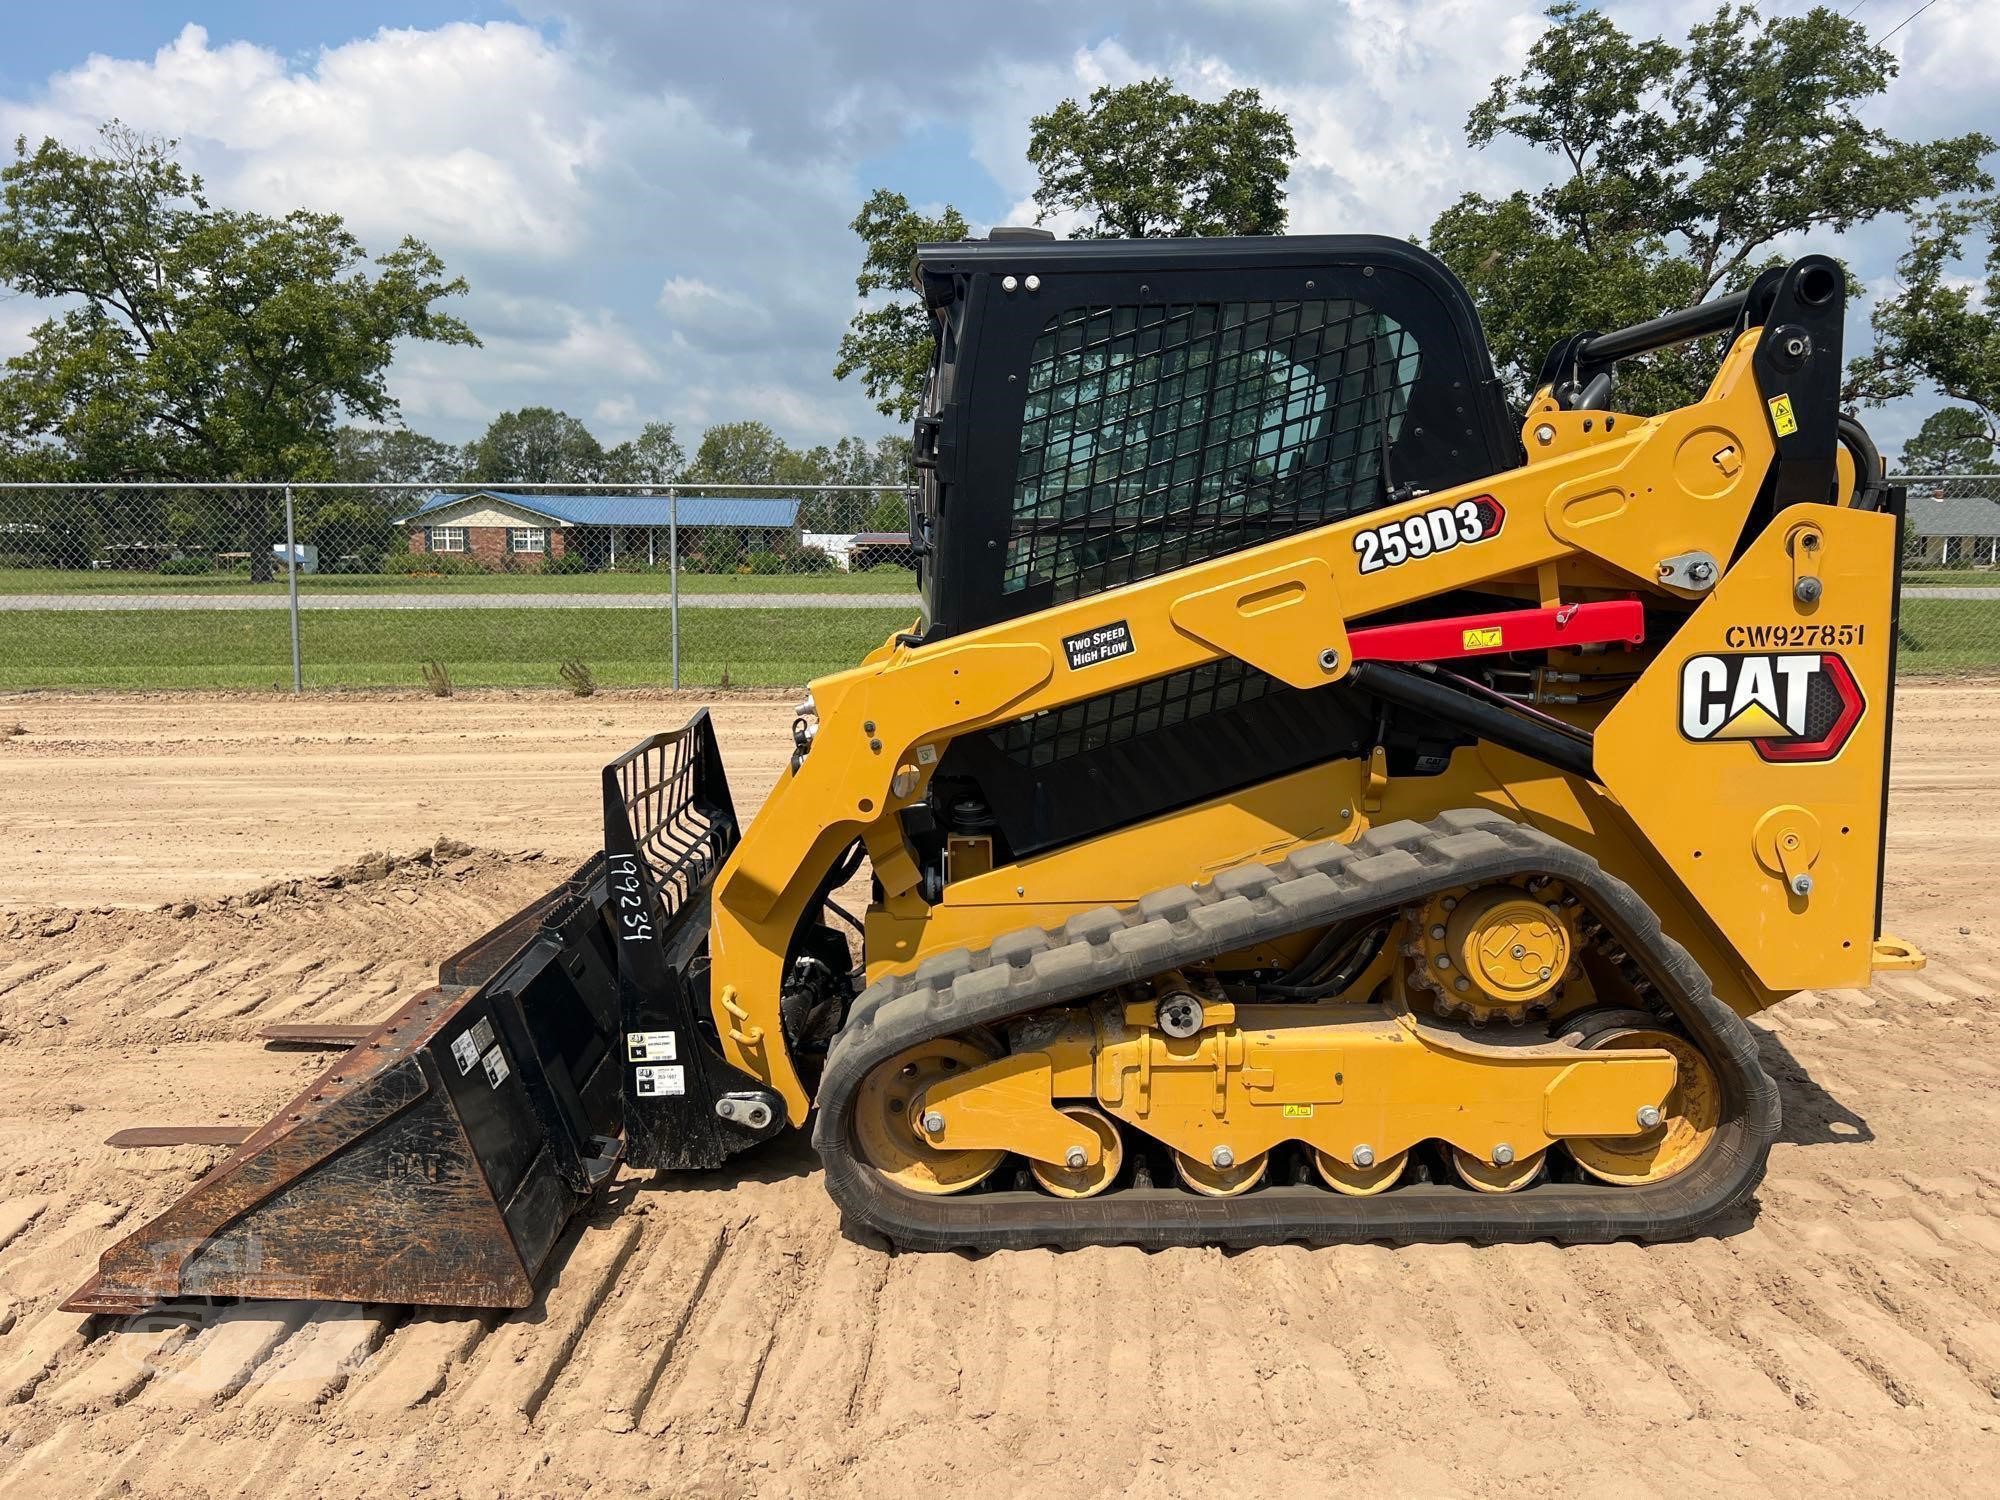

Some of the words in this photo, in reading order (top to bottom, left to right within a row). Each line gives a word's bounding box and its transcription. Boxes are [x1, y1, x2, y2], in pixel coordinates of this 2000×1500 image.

[1354, 501, 1483, 573] 259D3
[1725, 625, 1864, 647] CW927851
[1682, 655, 1821, 739] CAT
[609, 853, 653, 941] 199234
